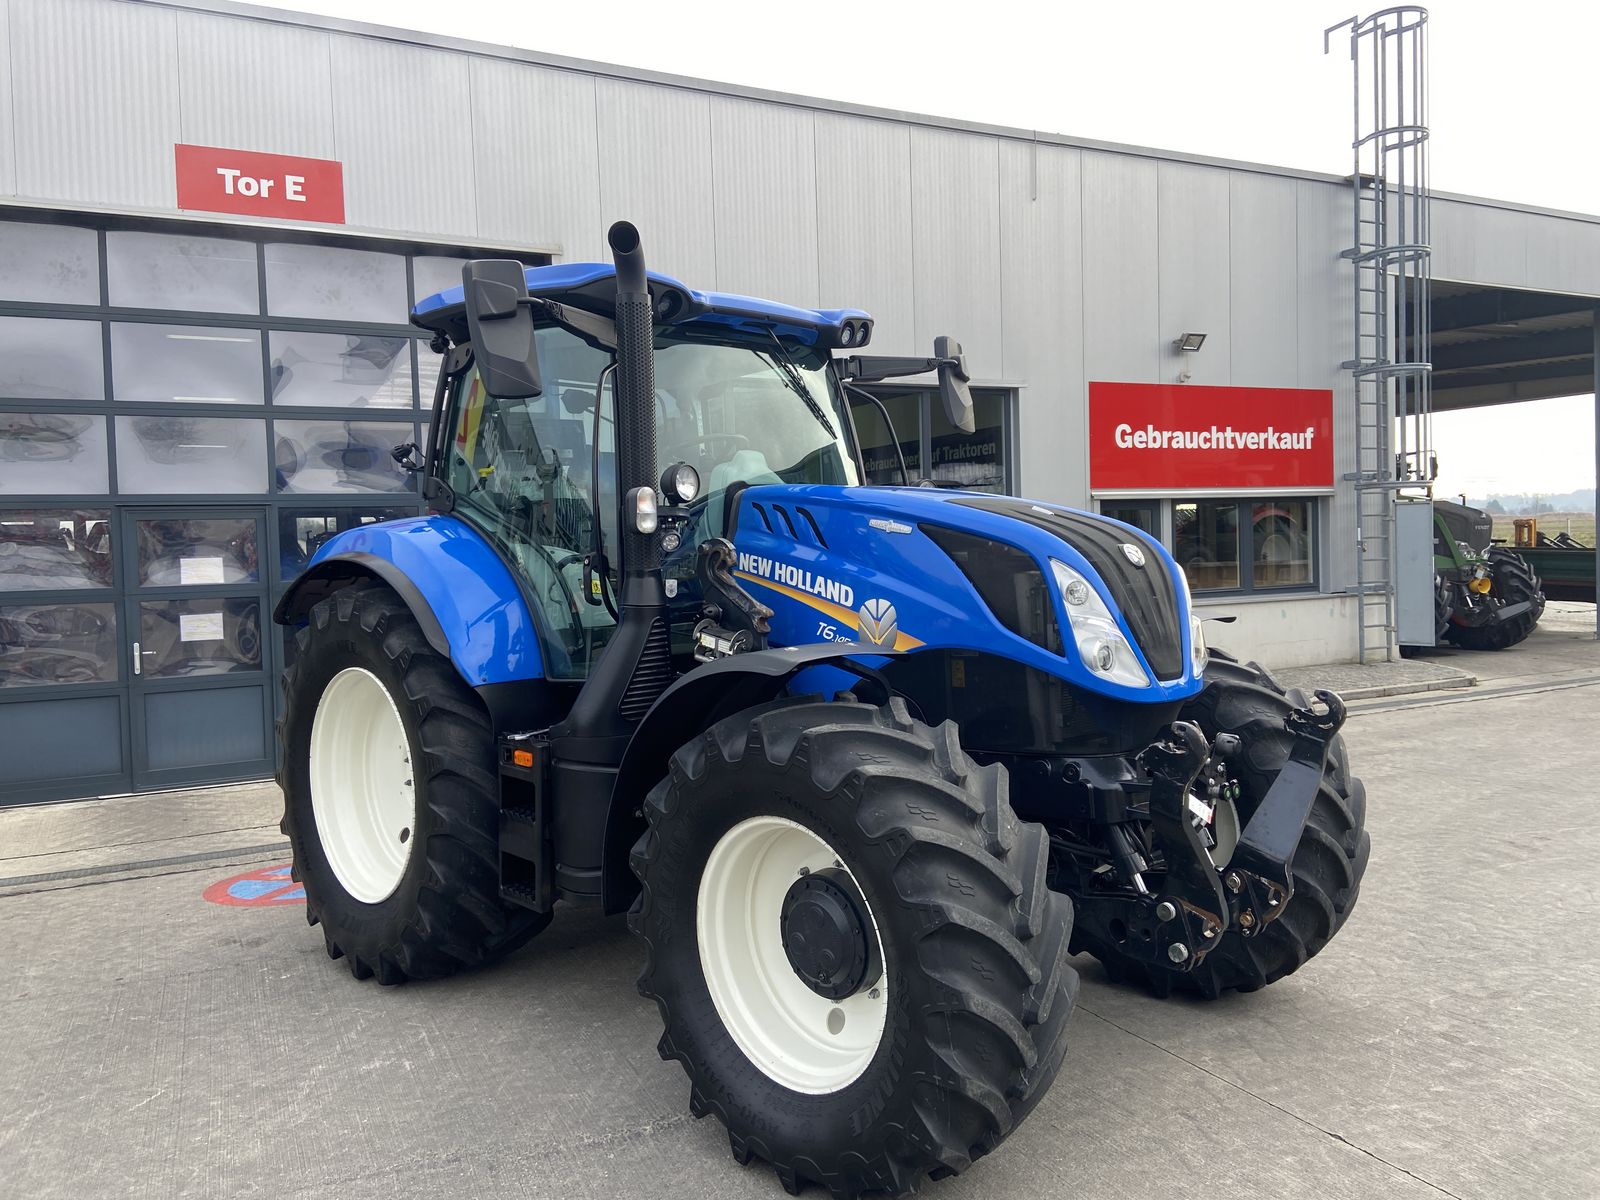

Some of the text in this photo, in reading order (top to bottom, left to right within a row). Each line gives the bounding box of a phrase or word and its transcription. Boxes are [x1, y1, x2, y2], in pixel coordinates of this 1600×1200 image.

[216, 167, 307, 202] Tor E
[943, 442, 996, 460] Traktoren
[1114, 423, 1315, 450] Gebrauchtverkauf
[738, 552, 855, 607] NEW HOLLAND
